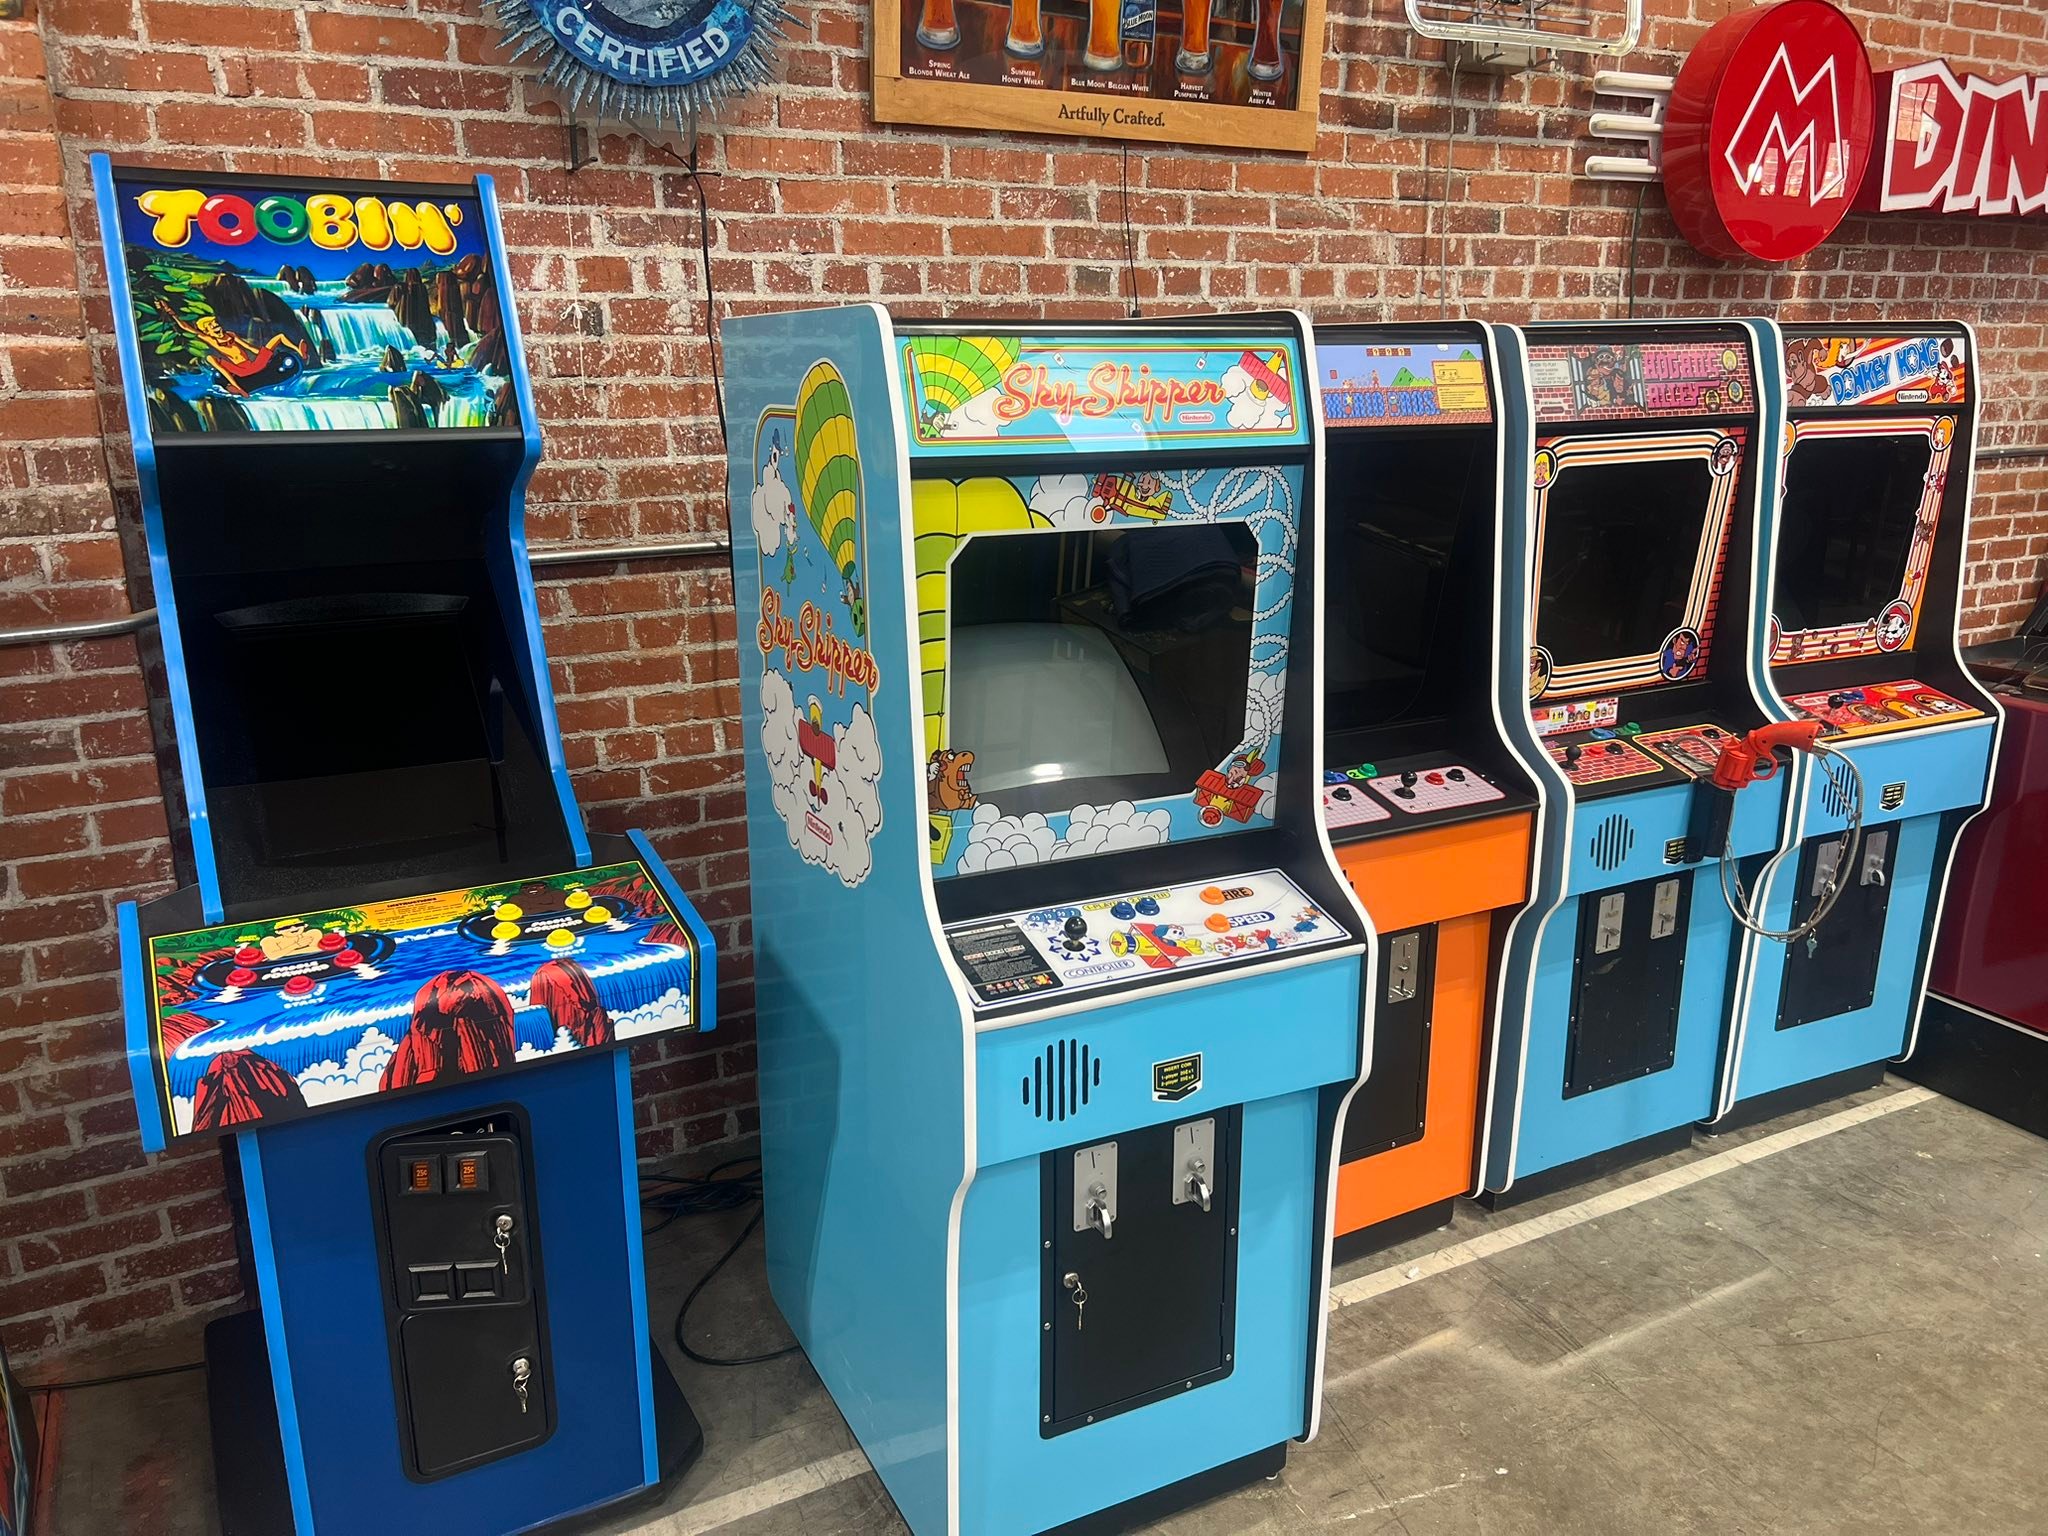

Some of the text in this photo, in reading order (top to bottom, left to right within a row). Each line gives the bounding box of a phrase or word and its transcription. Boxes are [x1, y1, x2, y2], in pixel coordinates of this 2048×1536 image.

[1138, 12, 1153, 23] MOON
[556, 6, 730, 79] CERTIFIED
[908, 67, 970, 80] BLONDE WHEAT ALE
[1010, 67, 1036, 77] SUMMER
[1001, 75, 1045, 86] HONEY WHEAT
[1071, 78, 1085, 87] BLUE
[1108, 80, 1131, 91] BELGIAN
[1131, 83, 1149, 92] WHITE
[1180, 82, 1203, 92] HARVEST
[1252, 88, 1272, 98] WINTER
[1174, 90, 1209, 100] PUMPKIN ALE
[1265, 97, 1276, 106] ALE
[1058, 103, 1165, 128] Artfully Crafted.
[1880, 59, 2048, 216] DIN
[133, 189, 463, 256] TOOBIN'
[1828, 336, 1940, 406] DONKEY KONG
[1898, 391, 1928, 401] Nintendo
[1223, 888, 1250, 901] FIRE
[1229, 913, 1271, 928] SPEED
[1068, 960, 1129, 978] CONTROLLER
[416, 1169, 428, 1177] 25¢
[463, 1166, 475, 1174] 25¢
